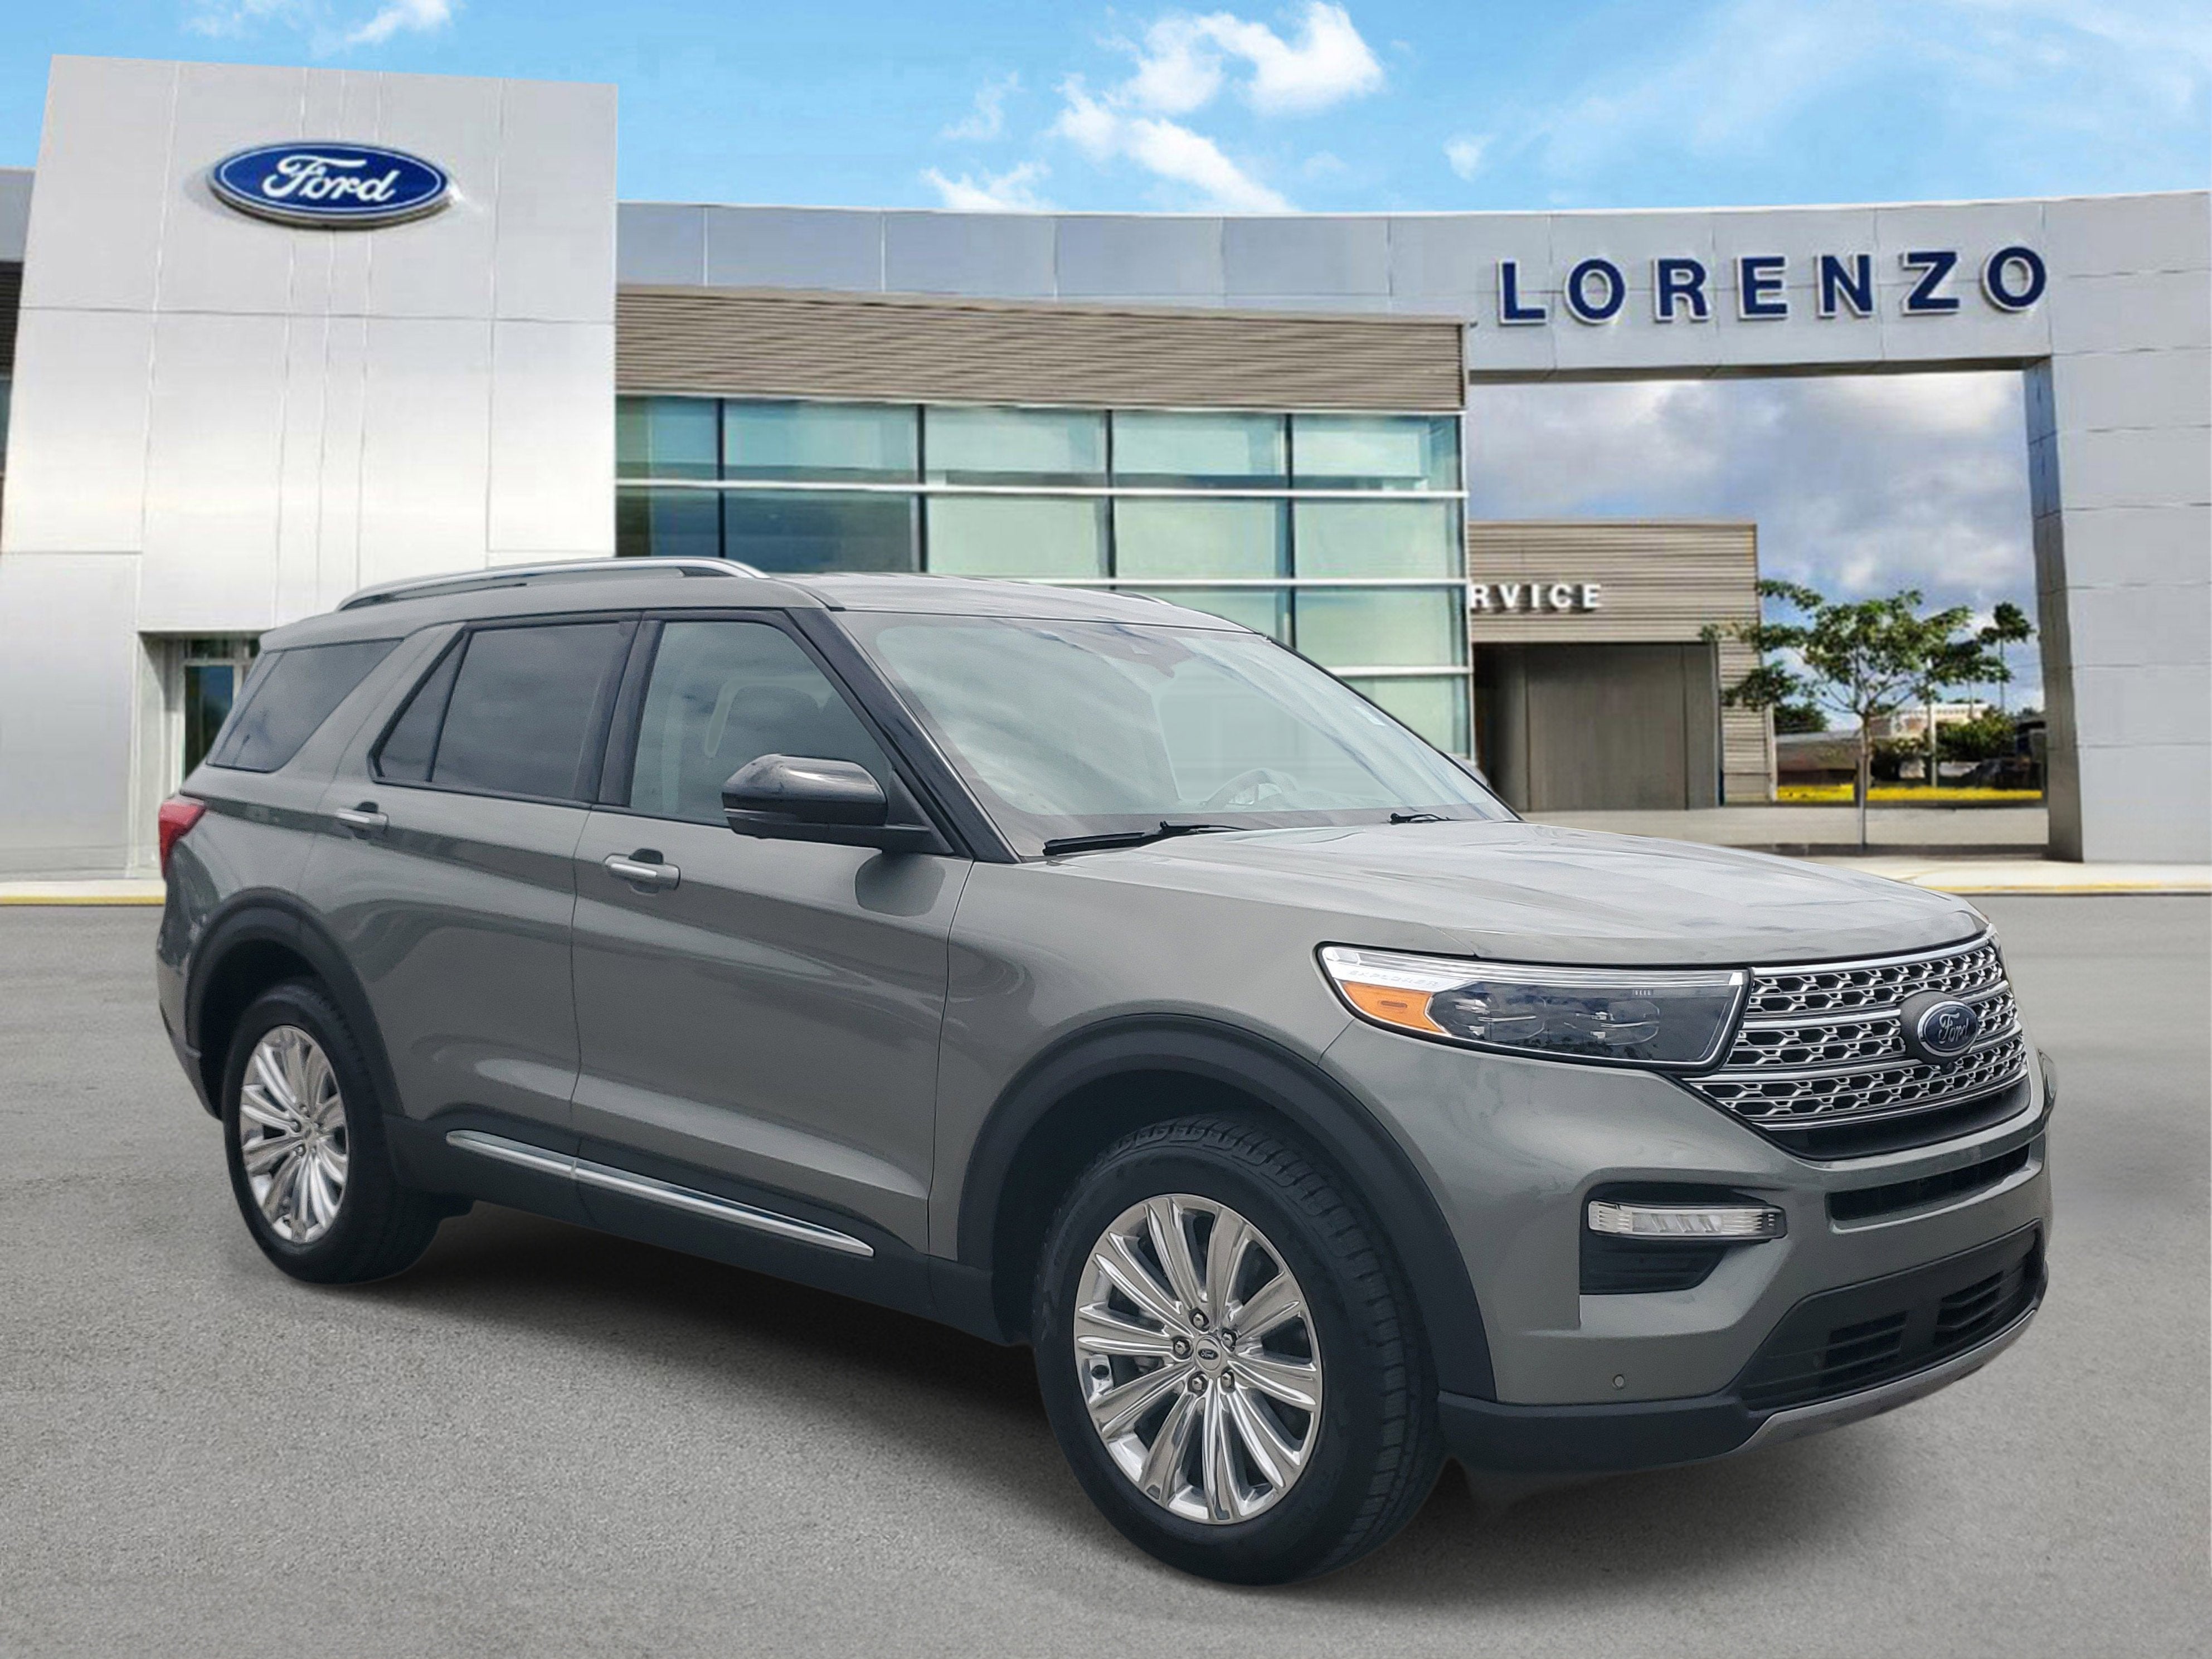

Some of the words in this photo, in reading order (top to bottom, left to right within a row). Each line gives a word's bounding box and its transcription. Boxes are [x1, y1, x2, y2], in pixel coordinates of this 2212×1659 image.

[262, 155, 400, 201] Ford
[1498, 246, 2047, 325] LORENZO
[1938, 1012, 1970, 1044] Ford
